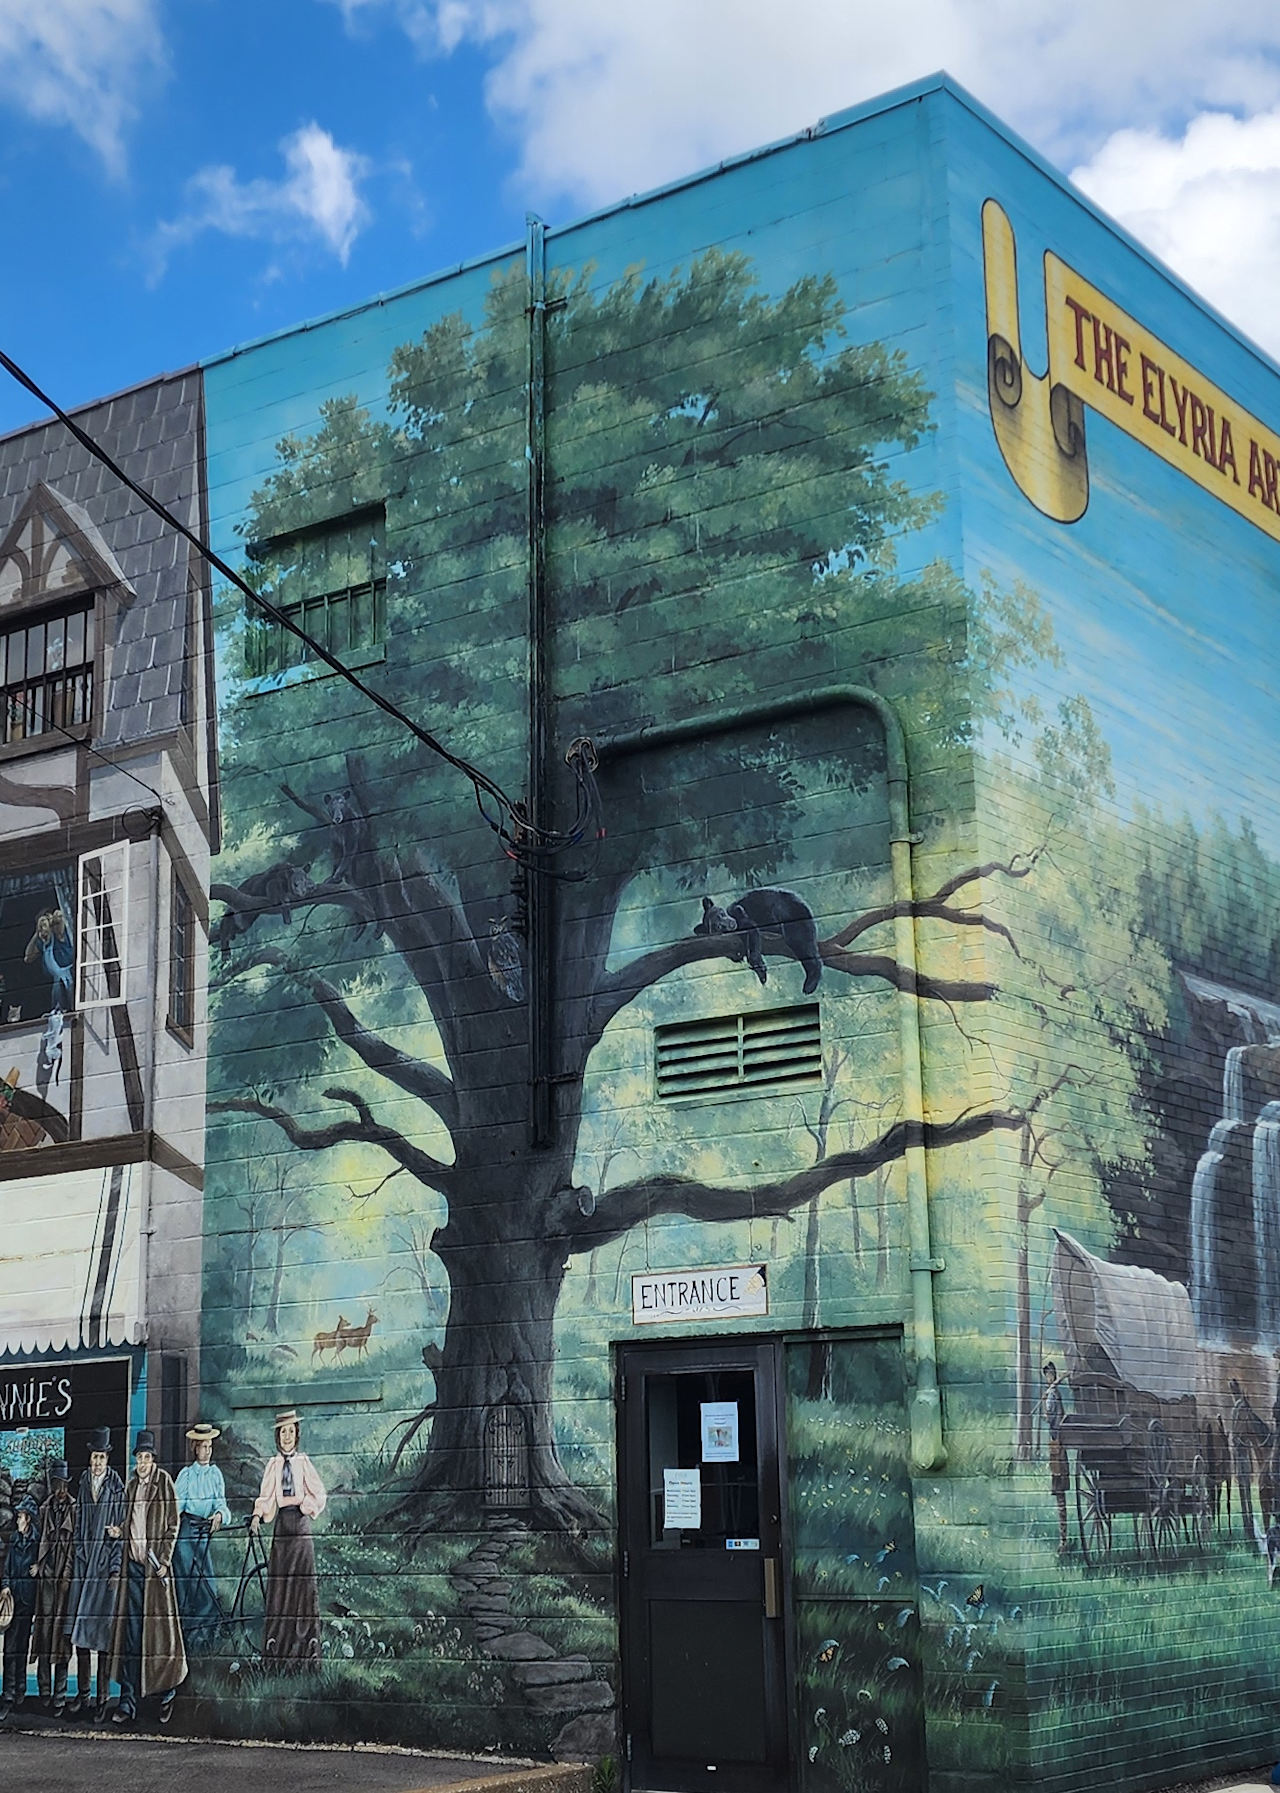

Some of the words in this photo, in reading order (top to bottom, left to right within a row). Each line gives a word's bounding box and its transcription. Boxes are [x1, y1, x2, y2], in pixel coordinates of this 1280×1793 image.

[1065, 295, 1135, 406] THE
[1139, 350, 1241, 485] ELYRIA
[640, 1275, 741, 1310] ENTRANCE
